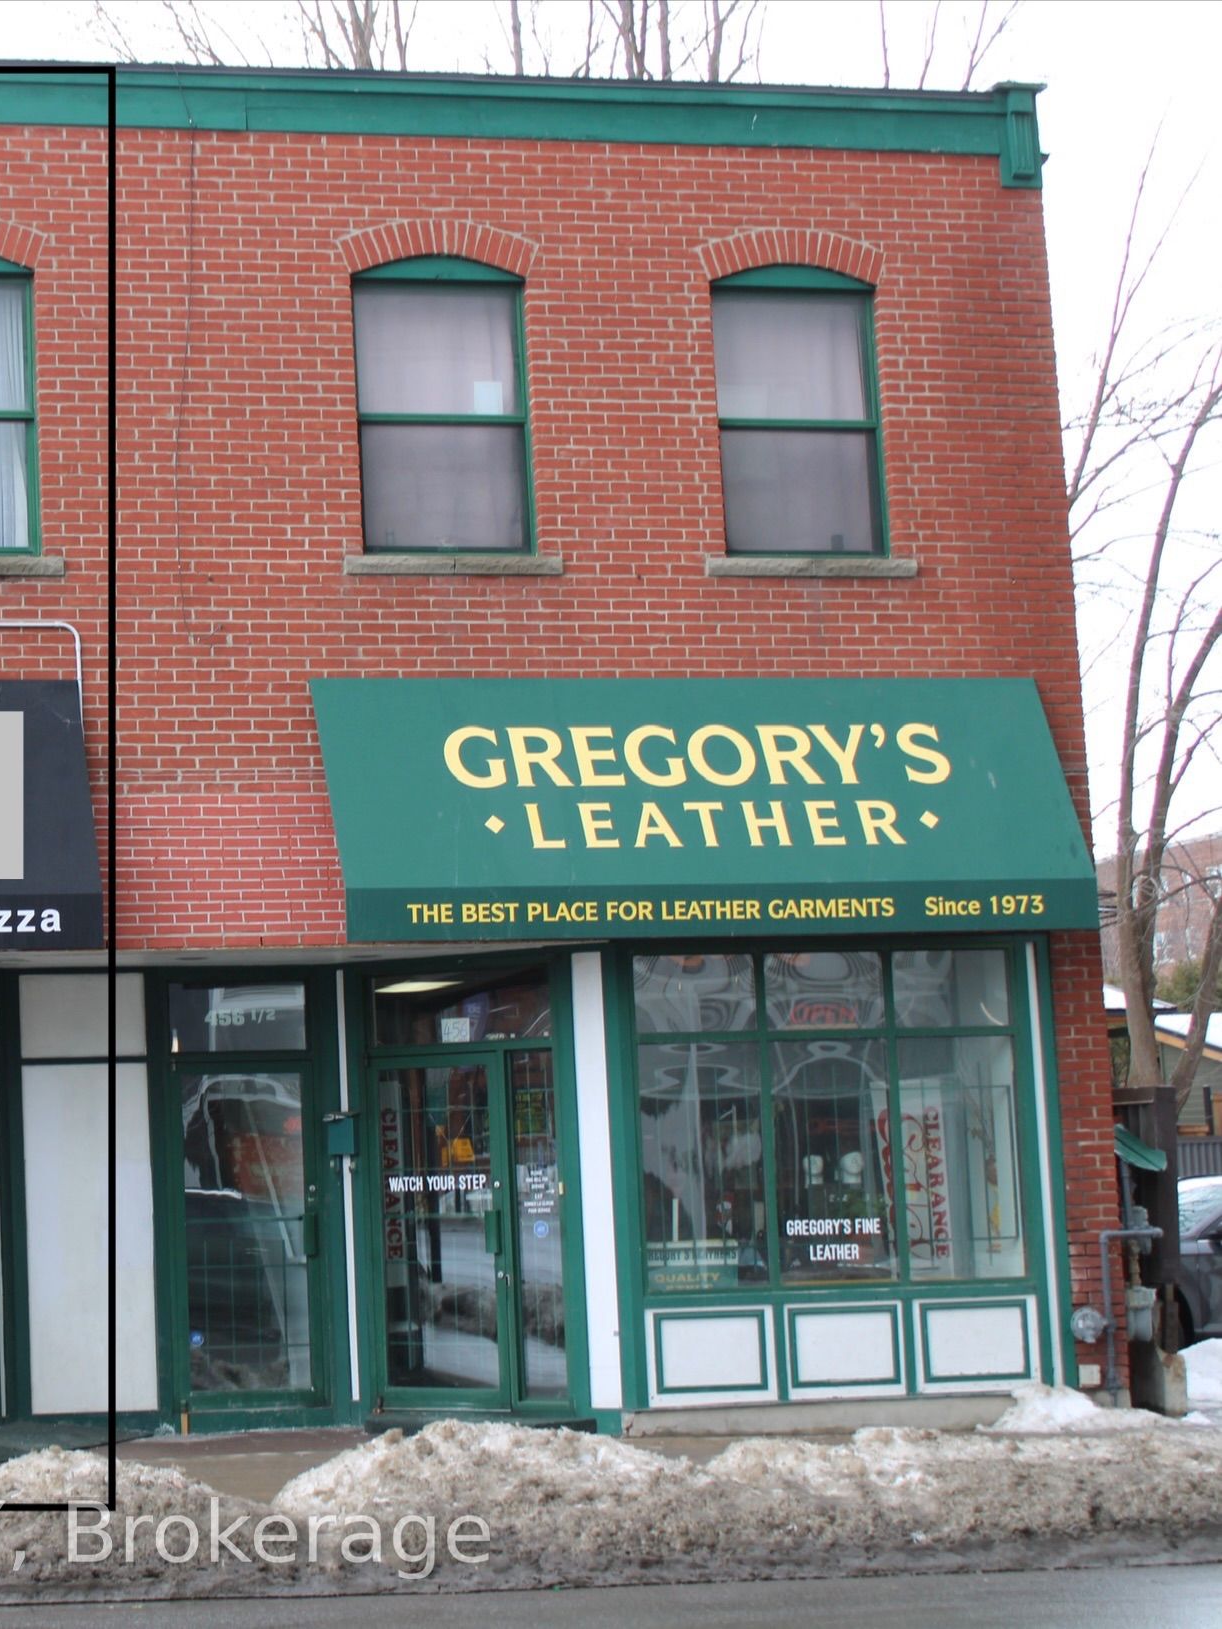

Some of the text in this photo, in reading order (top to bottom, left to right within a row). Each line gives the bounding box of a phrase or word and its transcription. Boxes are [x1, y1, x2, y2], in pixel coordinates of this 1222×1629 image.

[443, 723, 952, 789] GREGORY'S
[523, 800, 908, 849] LEATHER
[407, 894, 1045, 924] THE BEST PLACE FOR LEATHER GARMENTS Since 1973
[204, 1009, 277, 1027] 456 1/2
[389, 1173, 487, 1193] WATCH YOUR STEP
[923, 1106, 950, 1259] CLEARANCE
[786, 1217, 882, 1236] GREGORY'S FINE
[809, 1243, 860, 1261] LEATHER
